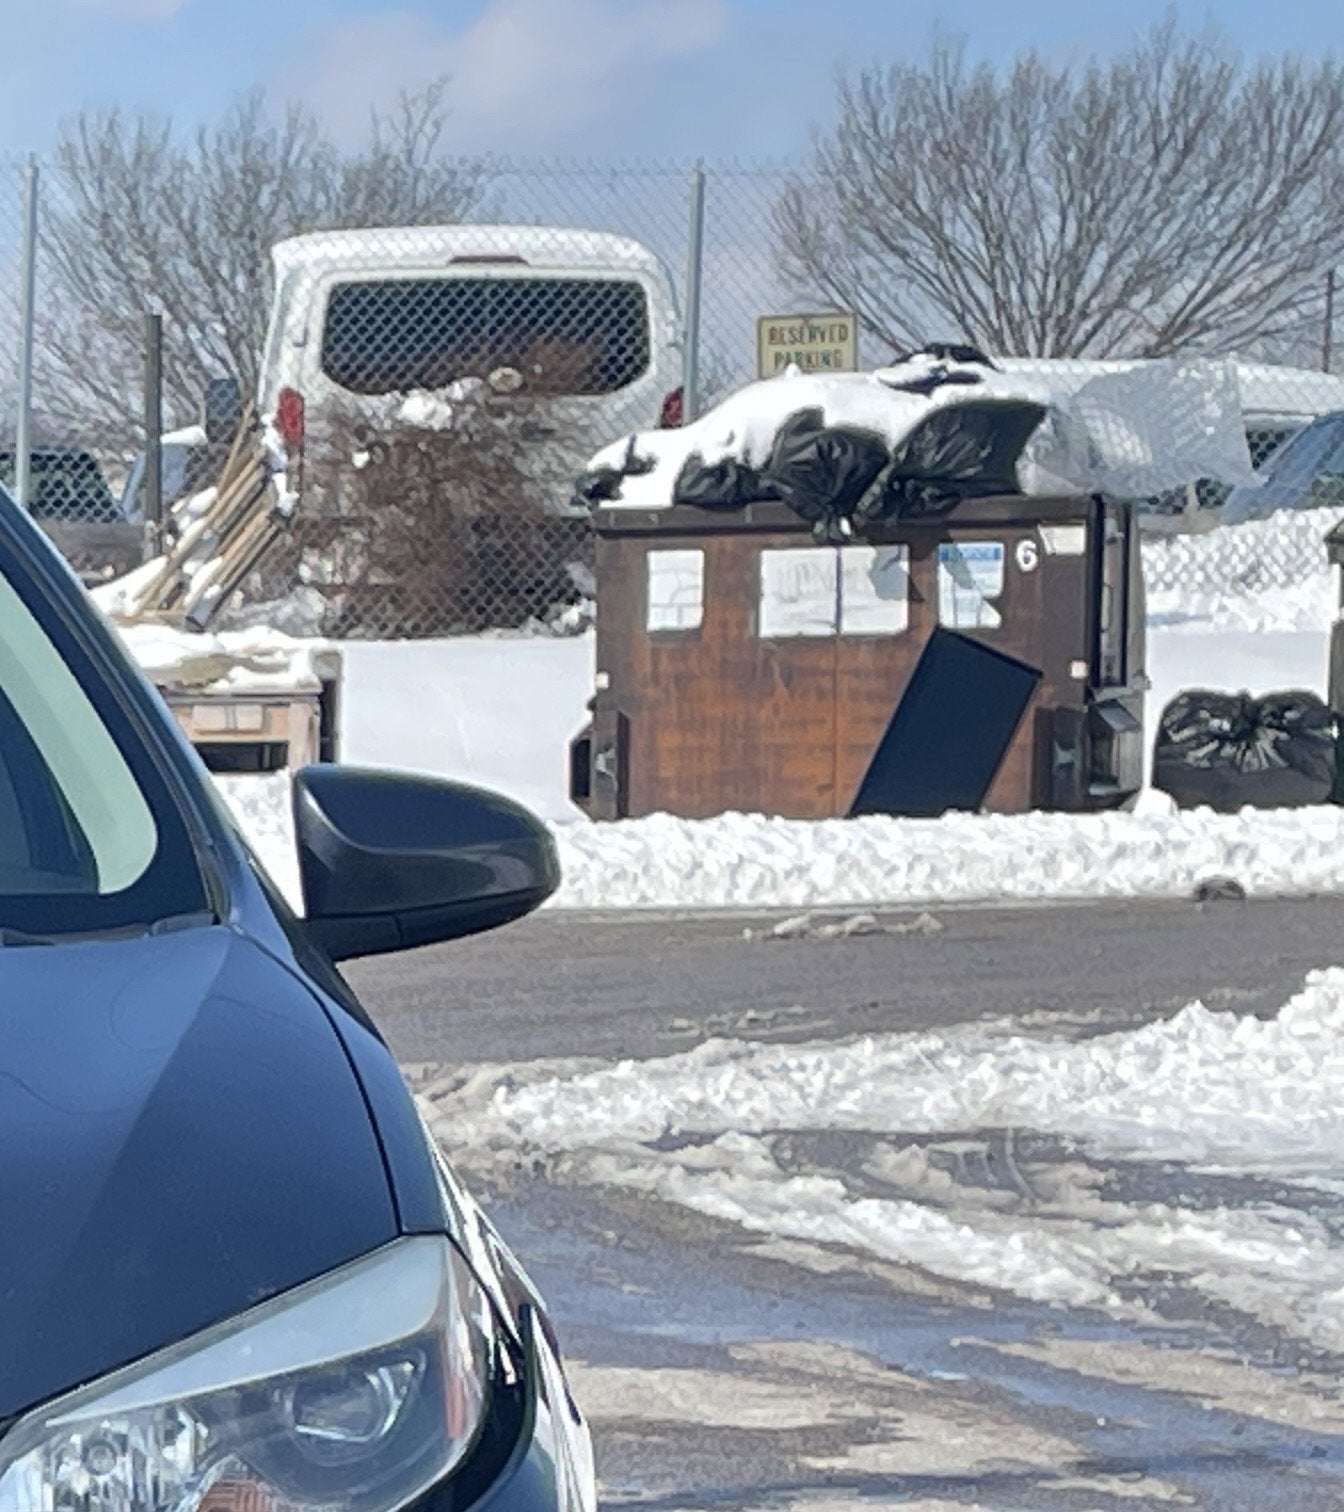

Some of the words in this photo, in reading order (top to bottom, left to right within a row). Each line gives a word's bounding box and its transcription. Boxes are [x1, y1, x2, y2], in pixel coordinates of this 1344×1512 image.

[768, 324, 849, 345] RESERVED
[774, 349, 843, 370] PARKING
[1016, 539, 1039, 573] 6
